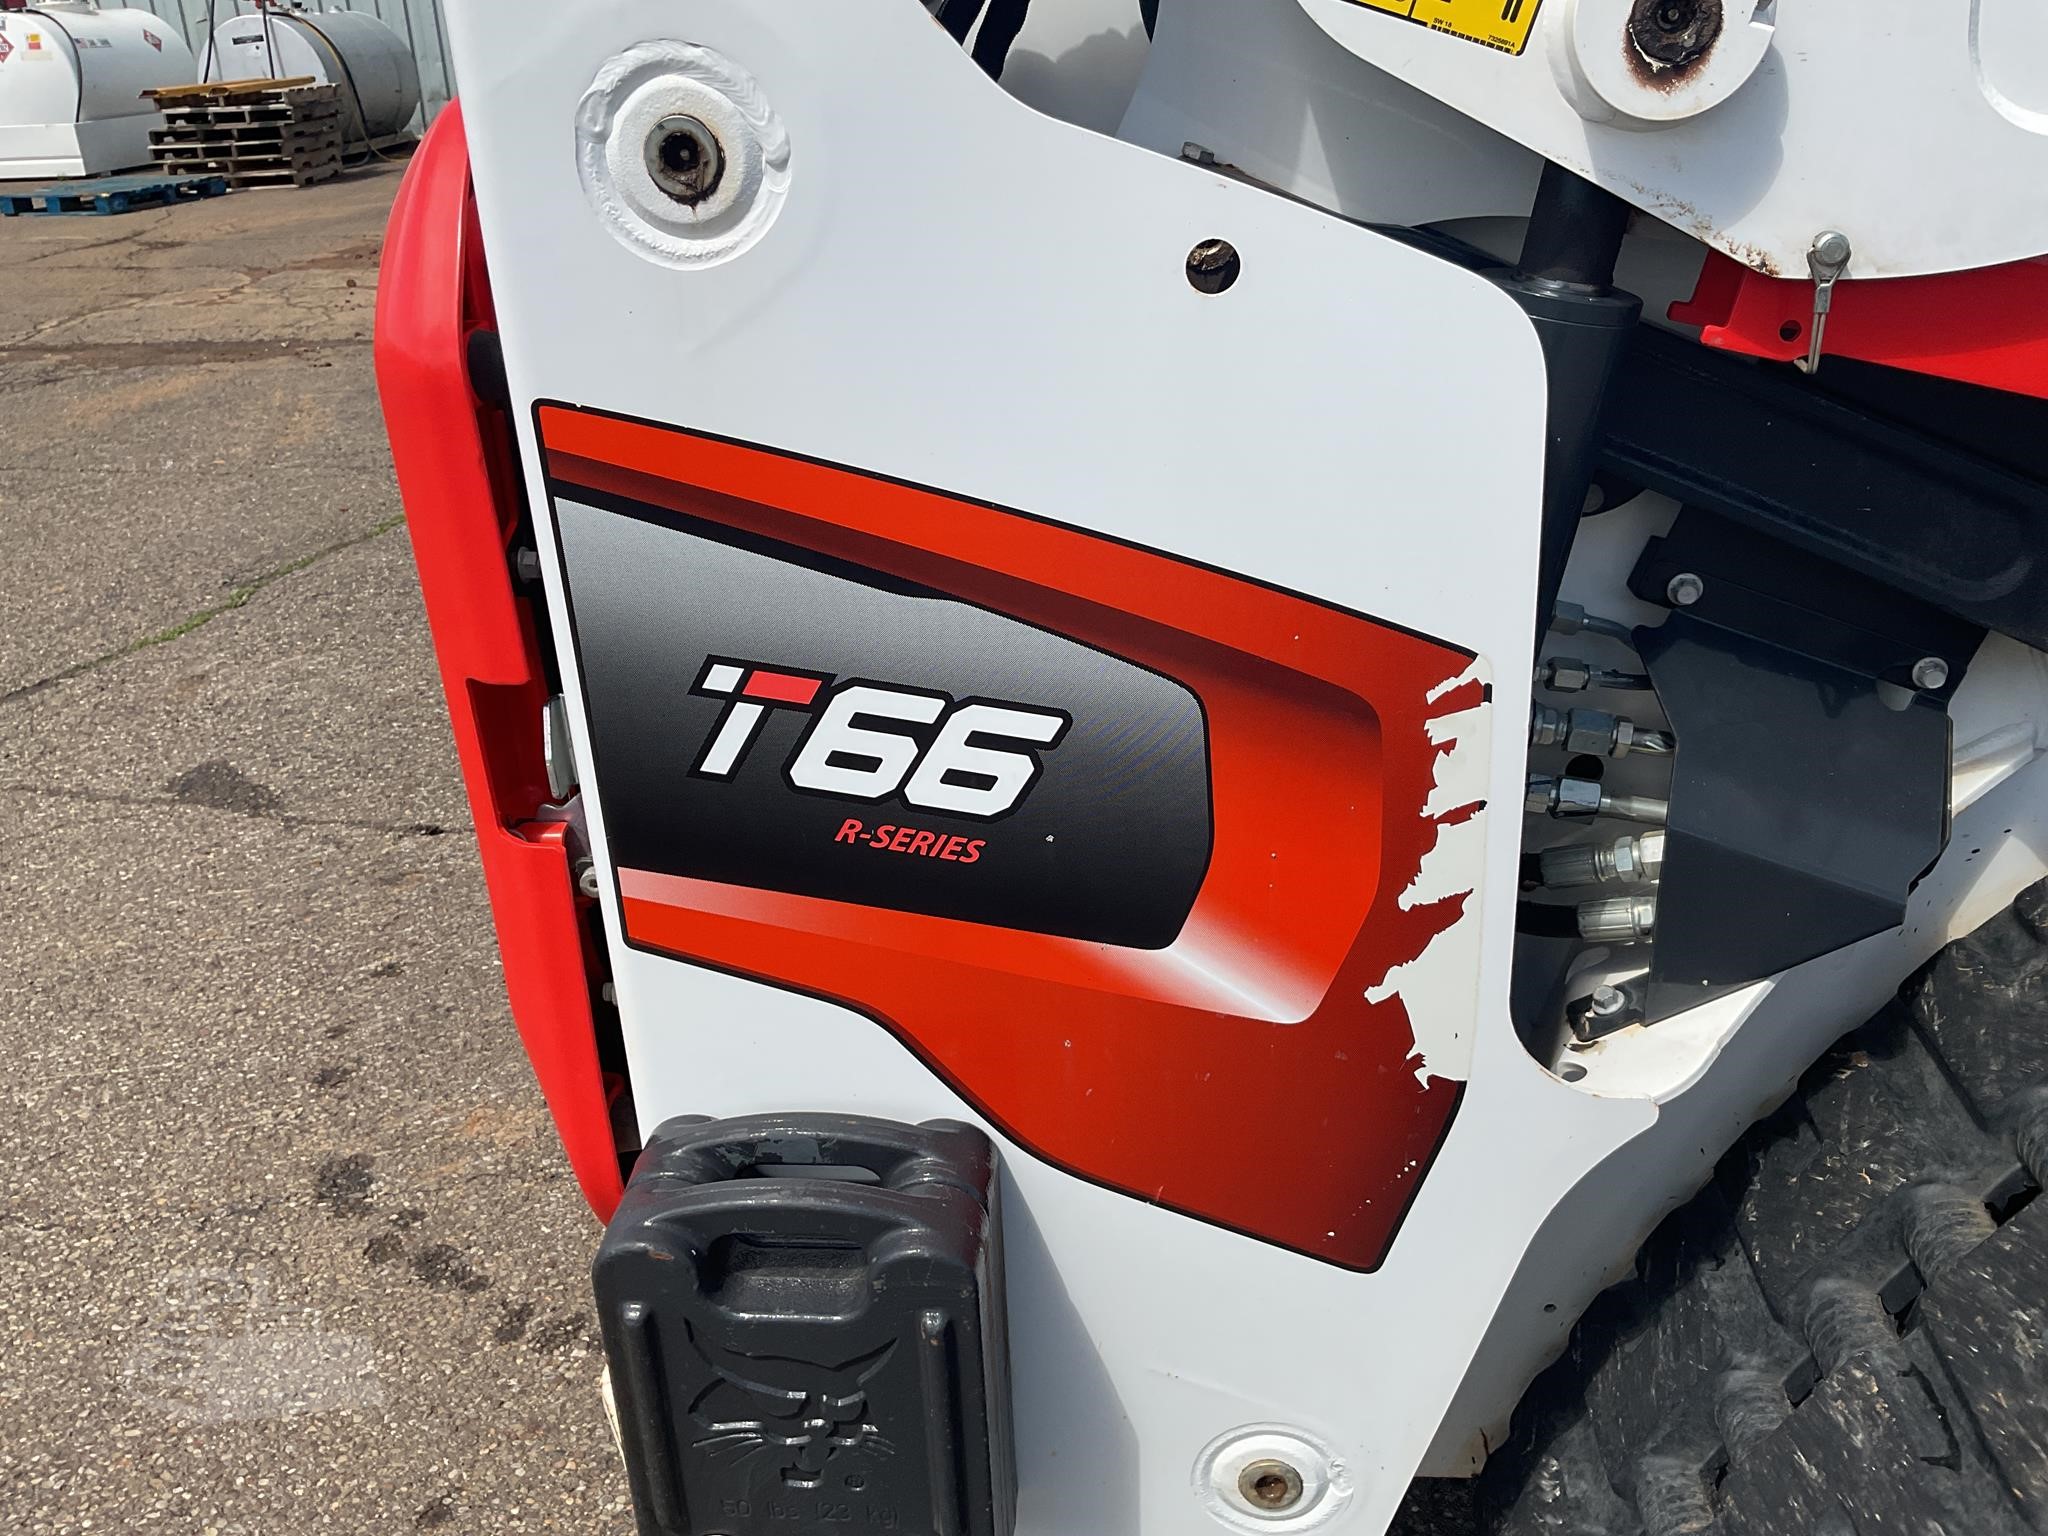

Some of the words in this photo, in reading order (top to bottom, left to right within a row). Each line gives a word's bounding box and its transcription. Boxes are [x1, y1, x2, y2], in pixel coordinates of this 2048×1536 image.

[1433, 17, 1444, 25] SW
[695, 664, 1064, 817] T66
[834, 818, 987, 864] R-SERIES
[720, 1499, 751, 1519] 50
[767, 1500, 801, 1519] lbs
